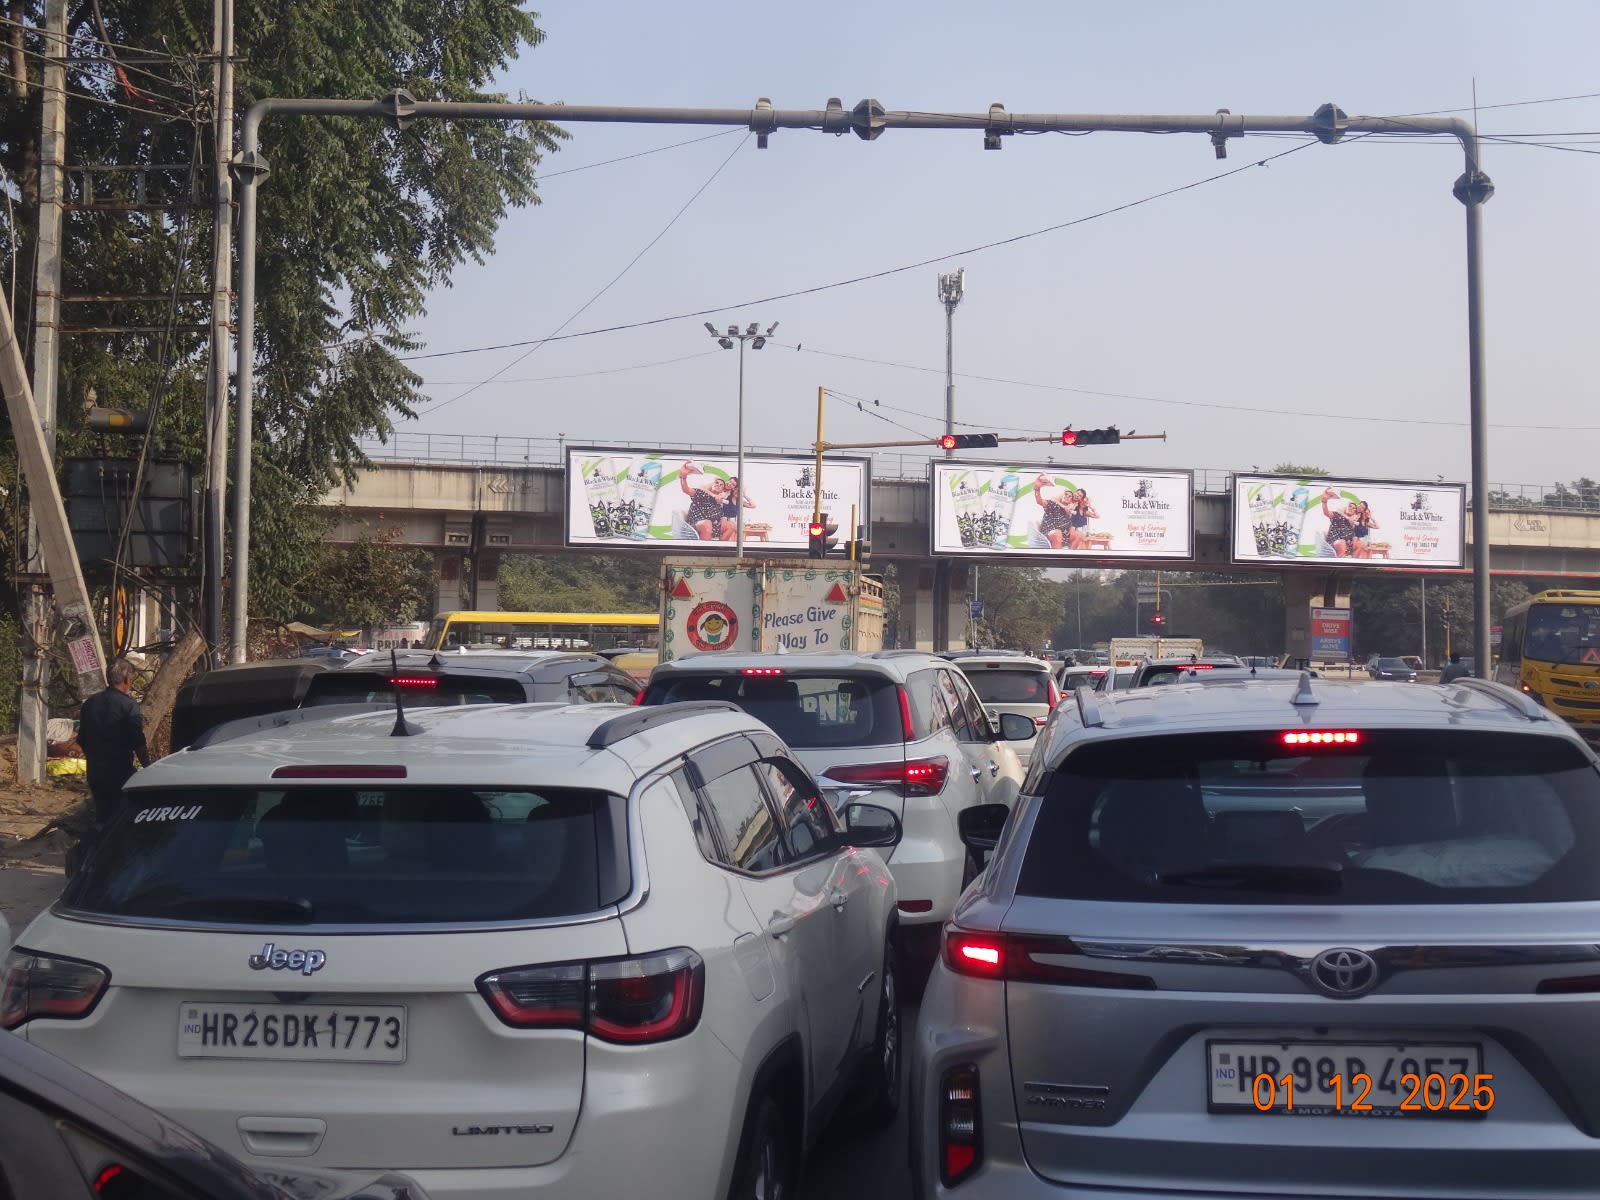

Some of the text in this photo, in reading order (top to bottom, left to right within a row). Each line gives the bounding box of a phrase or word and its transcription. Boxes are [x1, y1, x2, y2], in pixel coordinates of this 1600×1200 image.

[765, 606, 836, 628] Please Give
[777, 628, 829, 649] Way To
[134, 805, 203, 824] GURUJI
[249, 943, 326, 976] Jeep
[184, 1012, 401, 1049] IND HR26DK1773
[1215, 1068, 1236, 1079] IND
[452, 1125, 554, 1136] LIMITED
